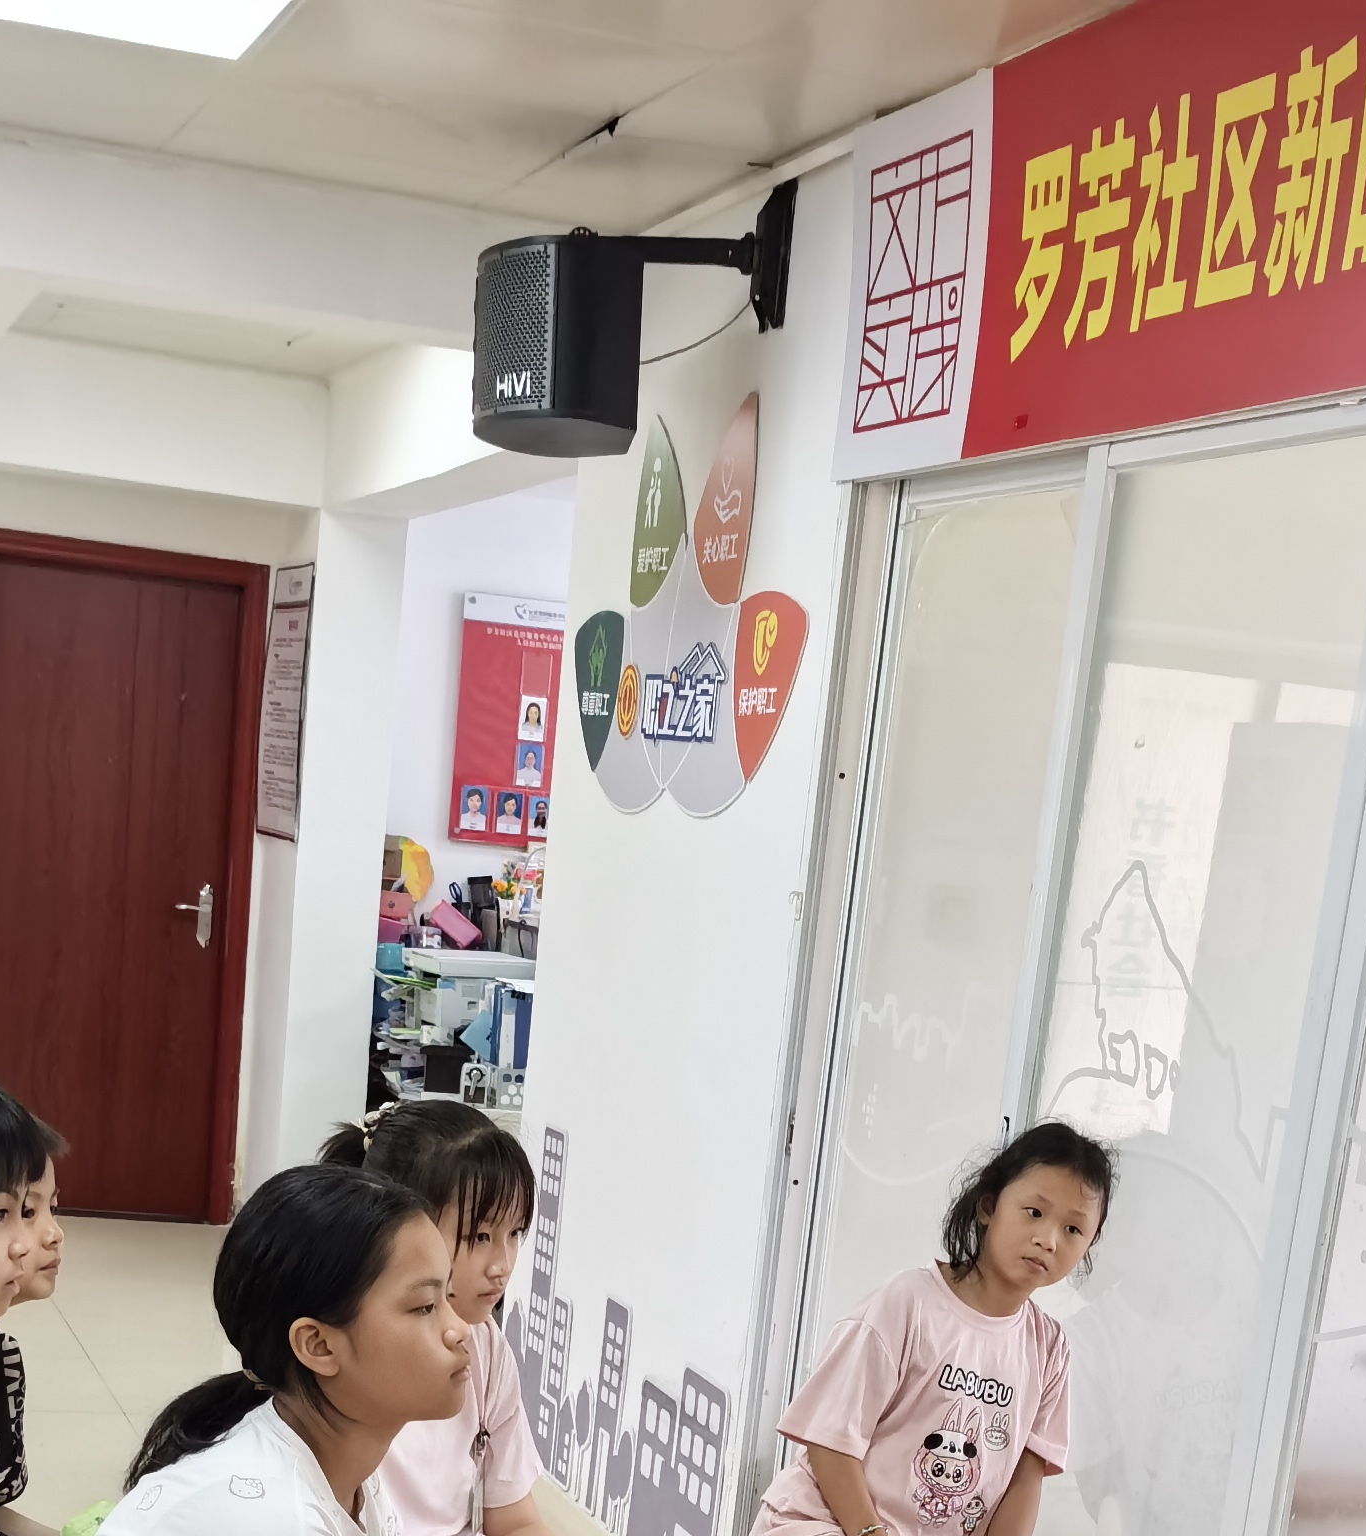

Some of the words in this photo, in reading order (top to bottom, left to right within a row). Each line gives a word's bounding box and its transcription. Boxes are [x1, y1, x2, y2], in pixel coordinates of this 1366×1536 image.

[702, 533, 739, 564] 关心职工
[738, 686, 778, 716] 保护职工
[938, 1364, 1013, 1407] LABUBU
